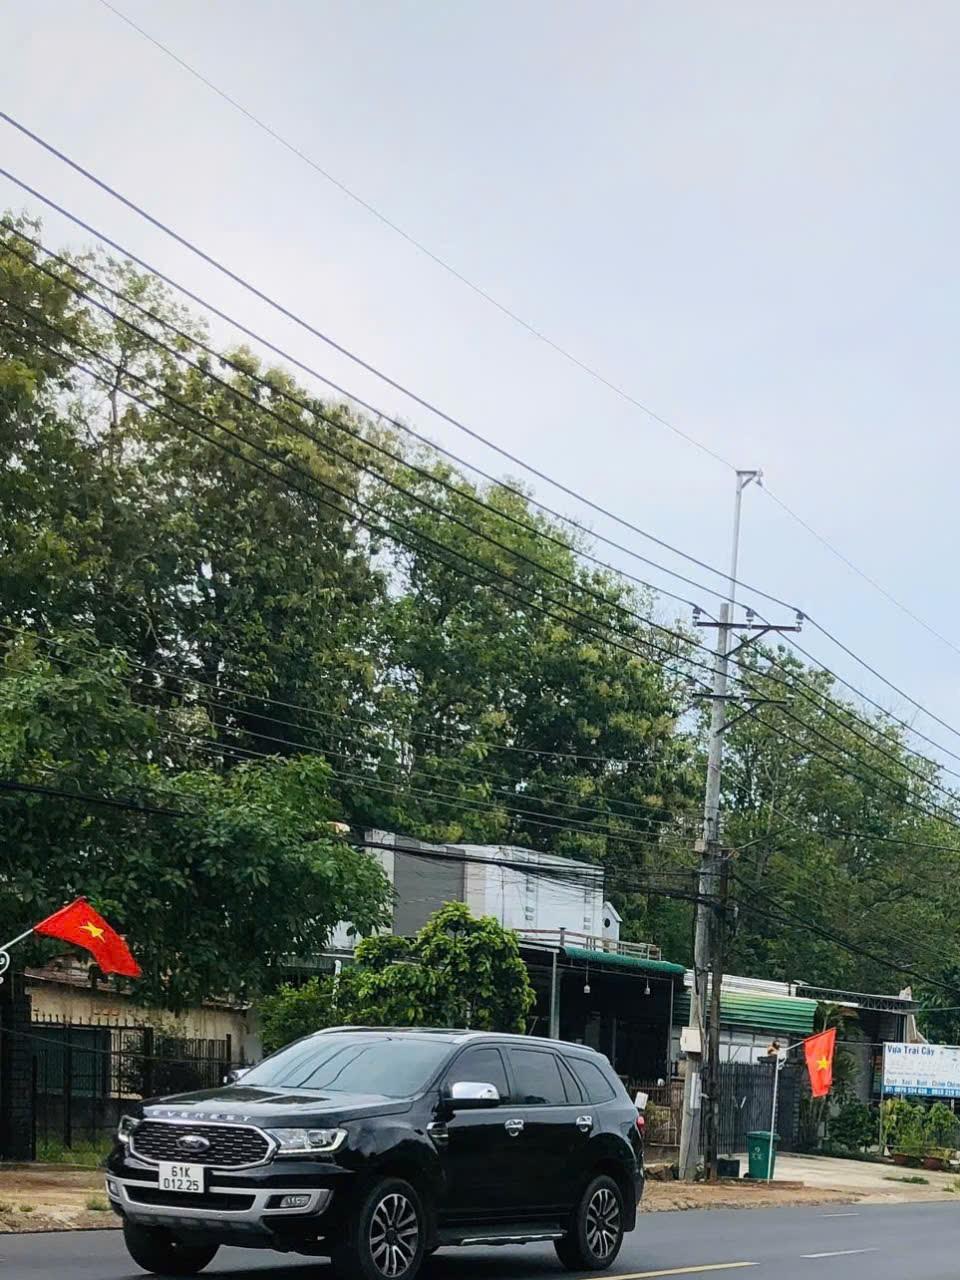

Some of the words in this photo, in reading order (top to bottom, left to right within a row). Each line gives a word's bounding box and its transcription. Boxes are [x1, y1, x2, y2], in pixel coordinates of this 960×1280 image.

[152, 1110, 251, 1122] EVEREST
[171, 1166, 191, 1178] 61K
[163, 1177, 200, 1192] 012.25
